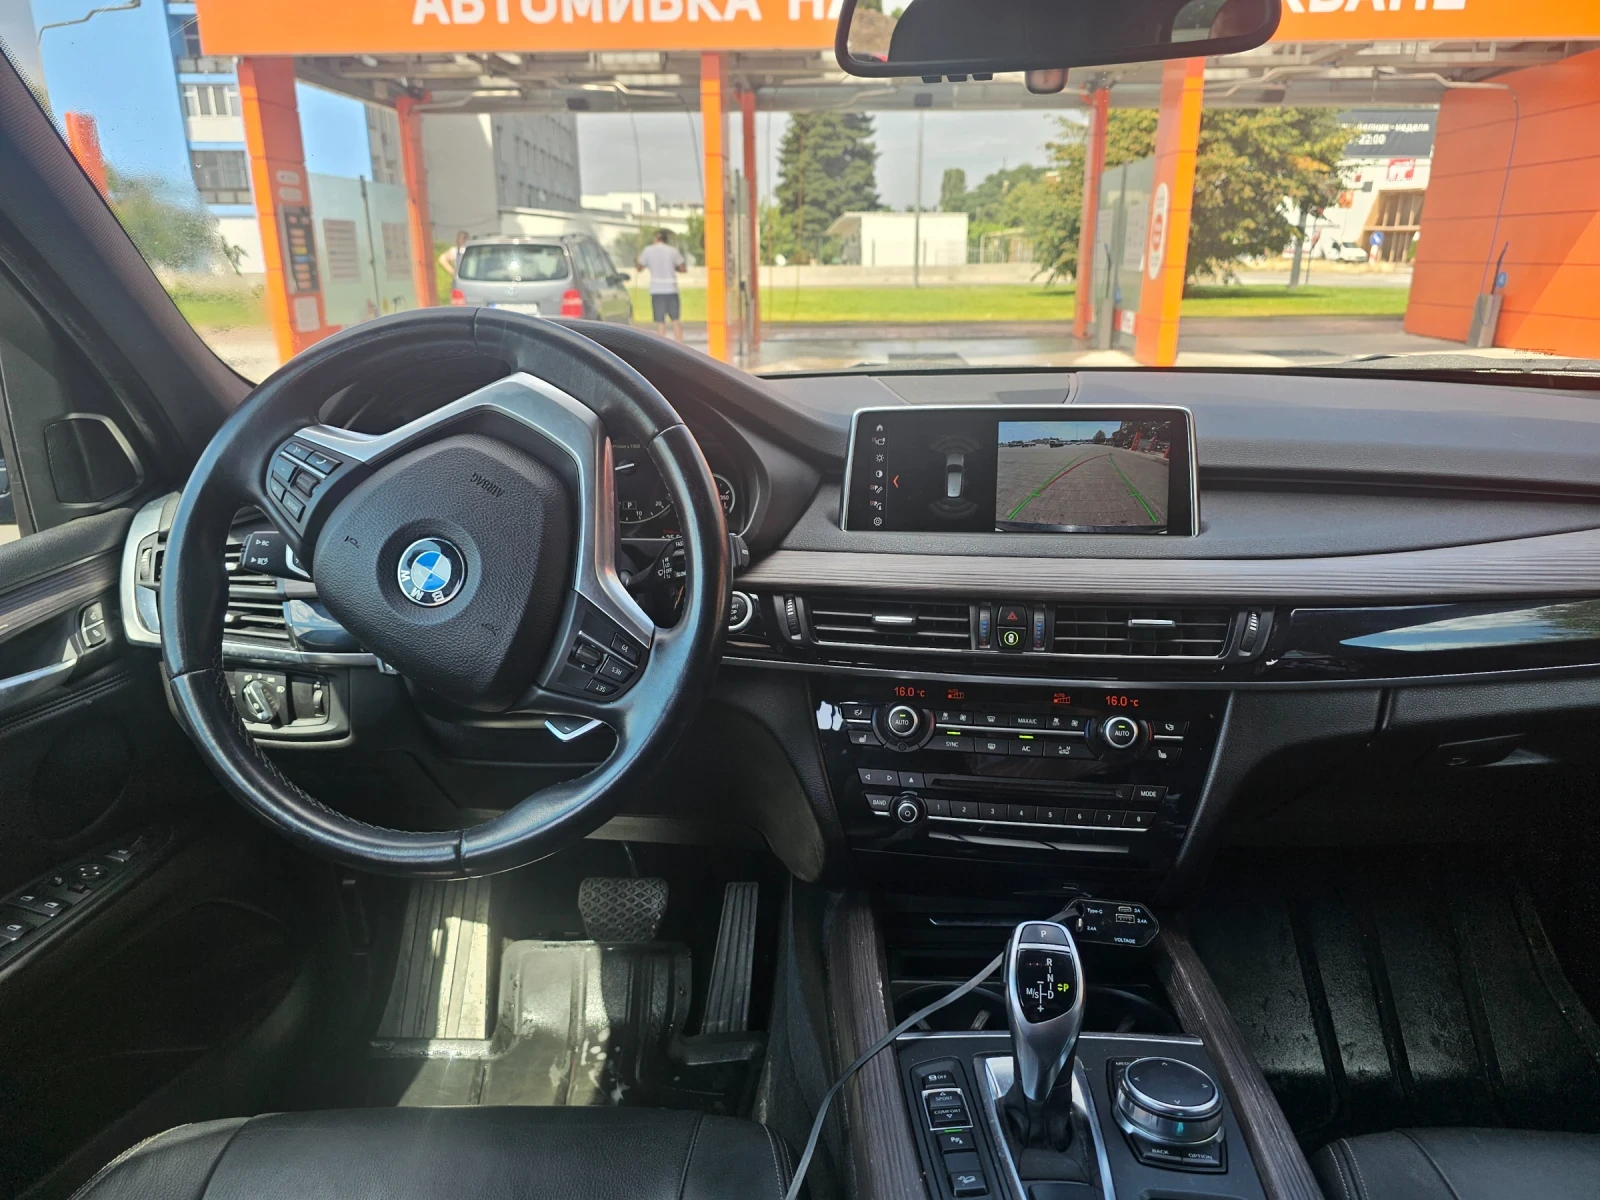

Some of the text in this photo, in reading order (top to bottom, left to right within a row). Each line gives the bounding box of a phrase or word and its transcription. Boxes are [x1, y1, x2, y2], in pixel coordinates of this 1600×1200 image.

[469, 472, 506, 498] AIRBAG
[611, 666, 623, 676] RES
[595, 684, 607, 693] SET
[894, 686, 915, 698] 16.0
[1105, 695, 1128, 708] 16.0
[1021, 745, 1031, 753] A/C
[1140, 790, 1157, 798] MODE
[1040, 930, 1047, 938] P
[1046, 958, 1053, 966] R
[1047, 973, 1054, 982] N
[1026, 987, 1040, 999] M/S
[1047, 990, 1054, 999] D
[1187, 1152, 1213, 1160] OPTION
